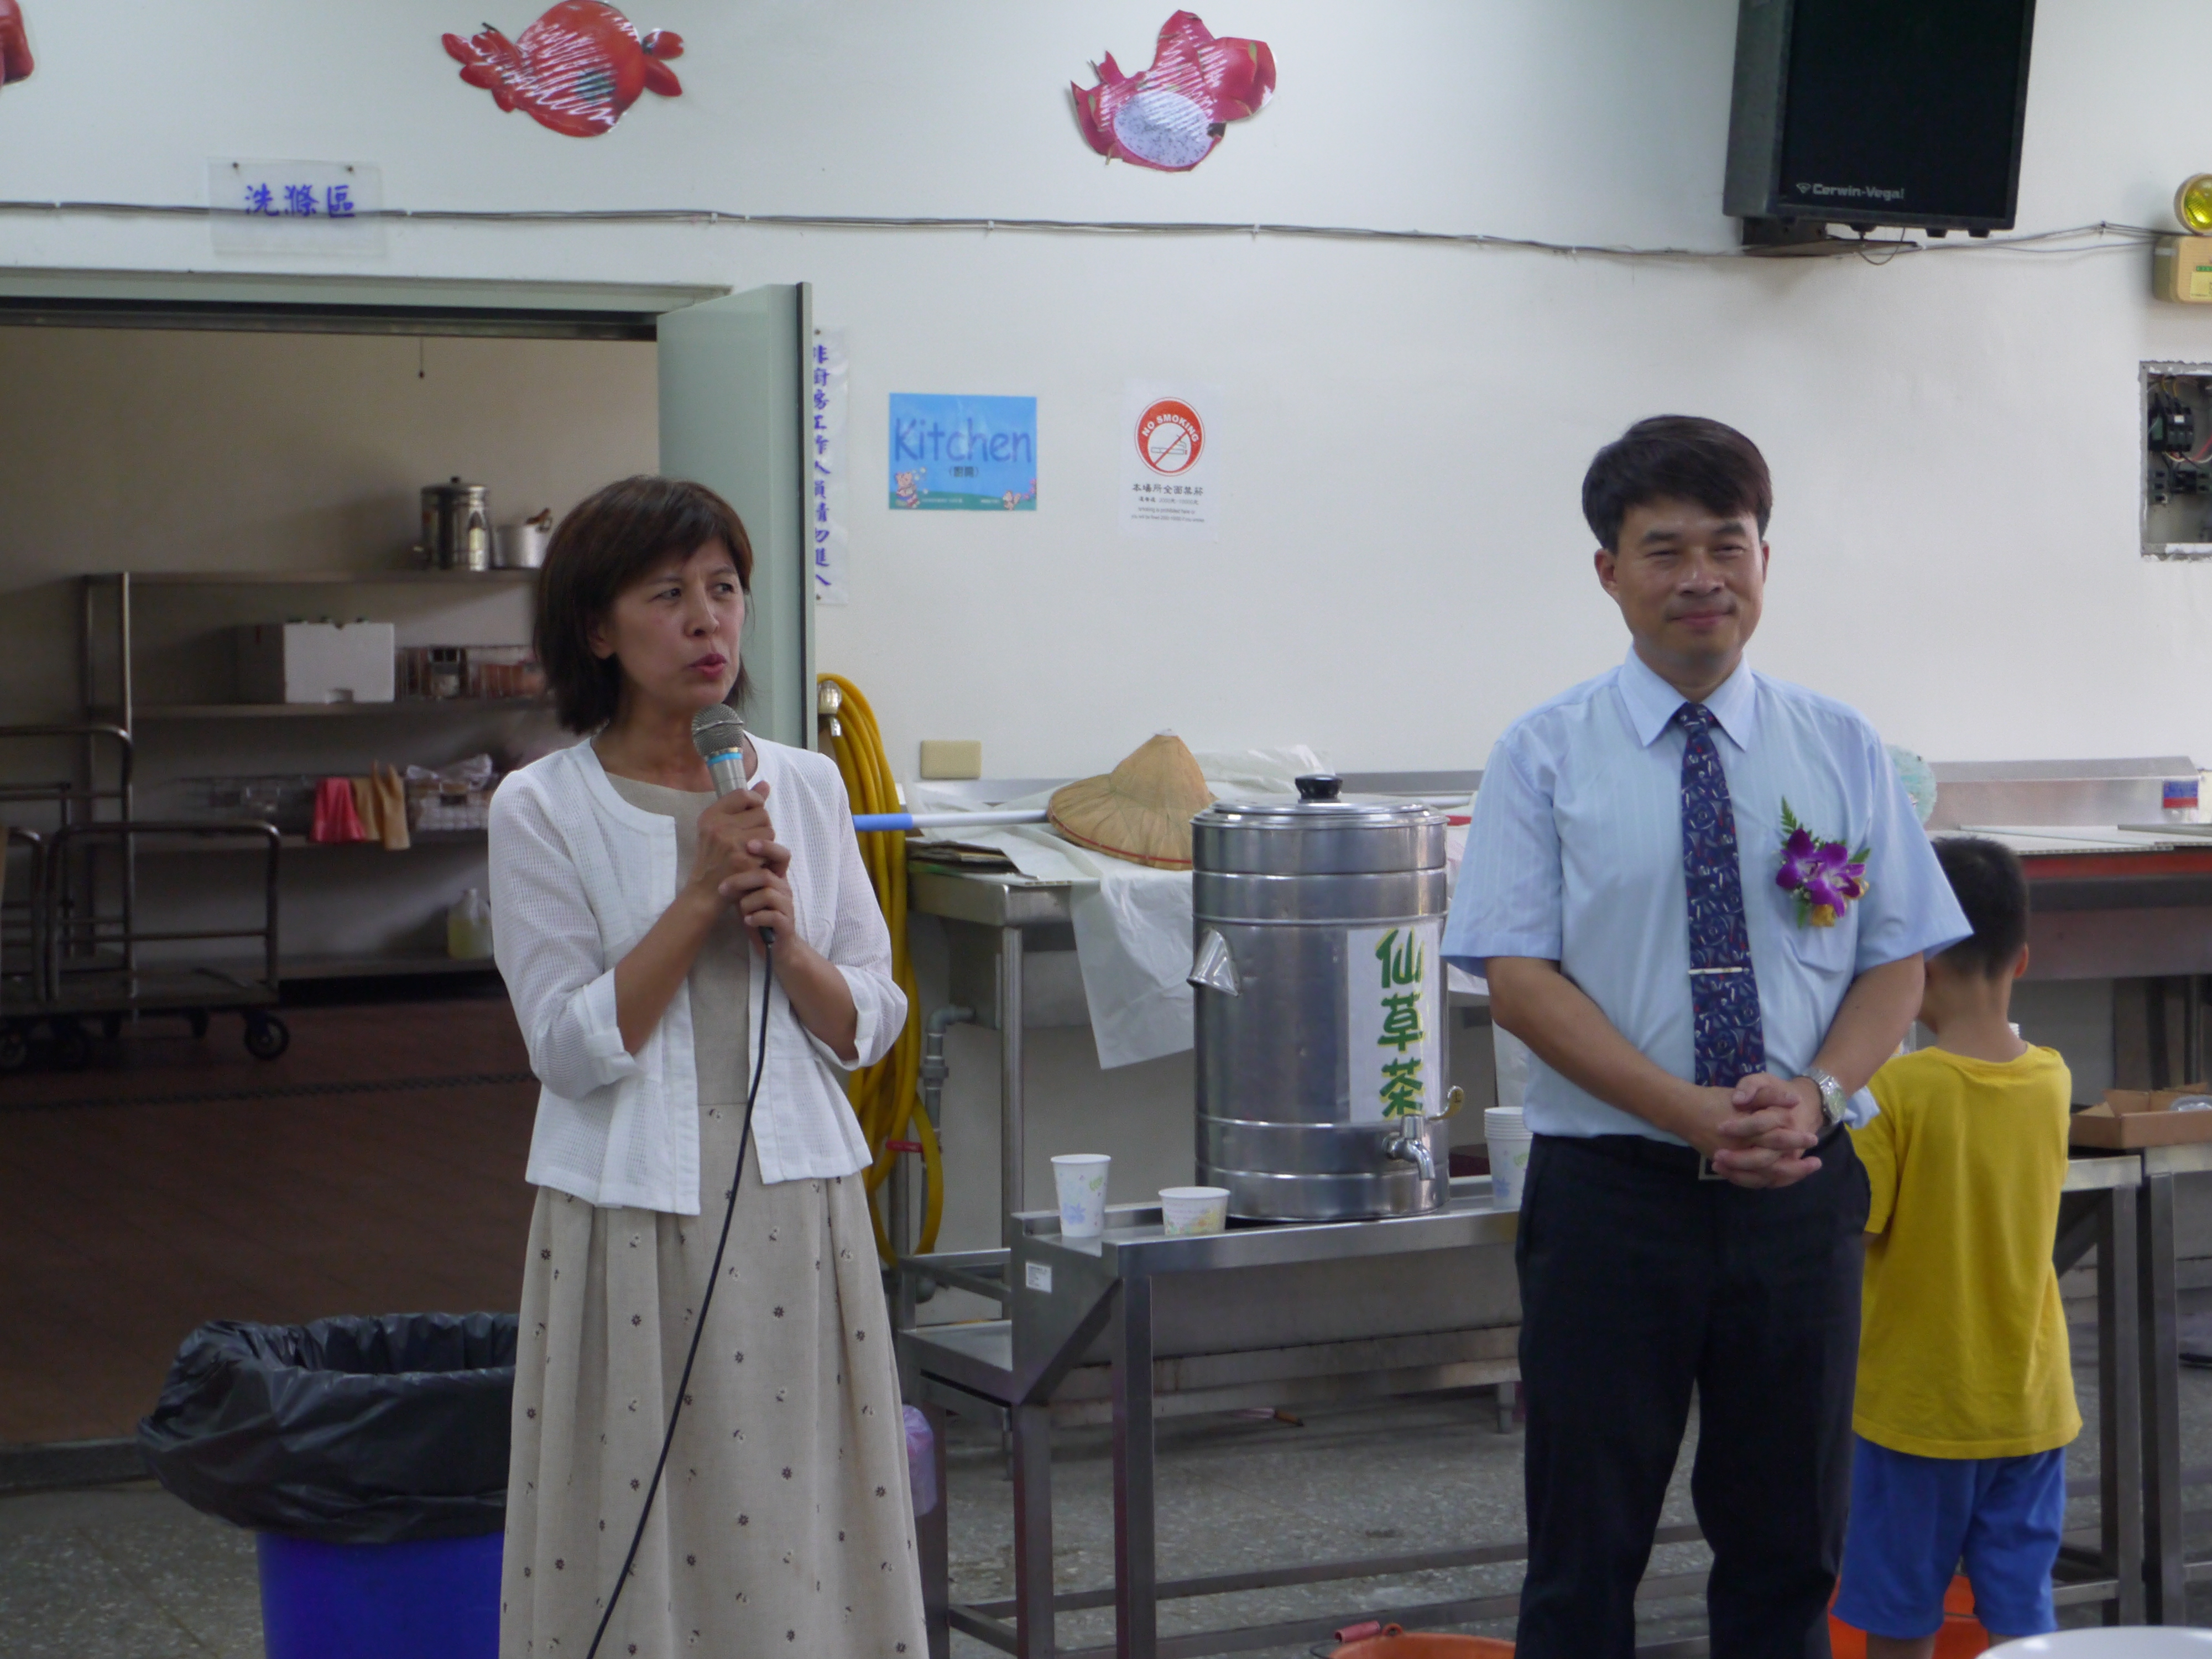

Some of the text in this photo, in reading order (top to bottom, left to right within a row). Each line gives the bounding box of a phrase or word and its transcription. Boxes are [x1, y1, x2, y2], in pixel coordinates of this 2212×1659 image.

[1812, 183, 1905, 201] Cerwin-Vega!
[894, 417, 1032, 463] Kitchen
[1141, 413, 1199, 442] NO SMOKING
[1375, 927, 1425, 1121] 仙草茶
